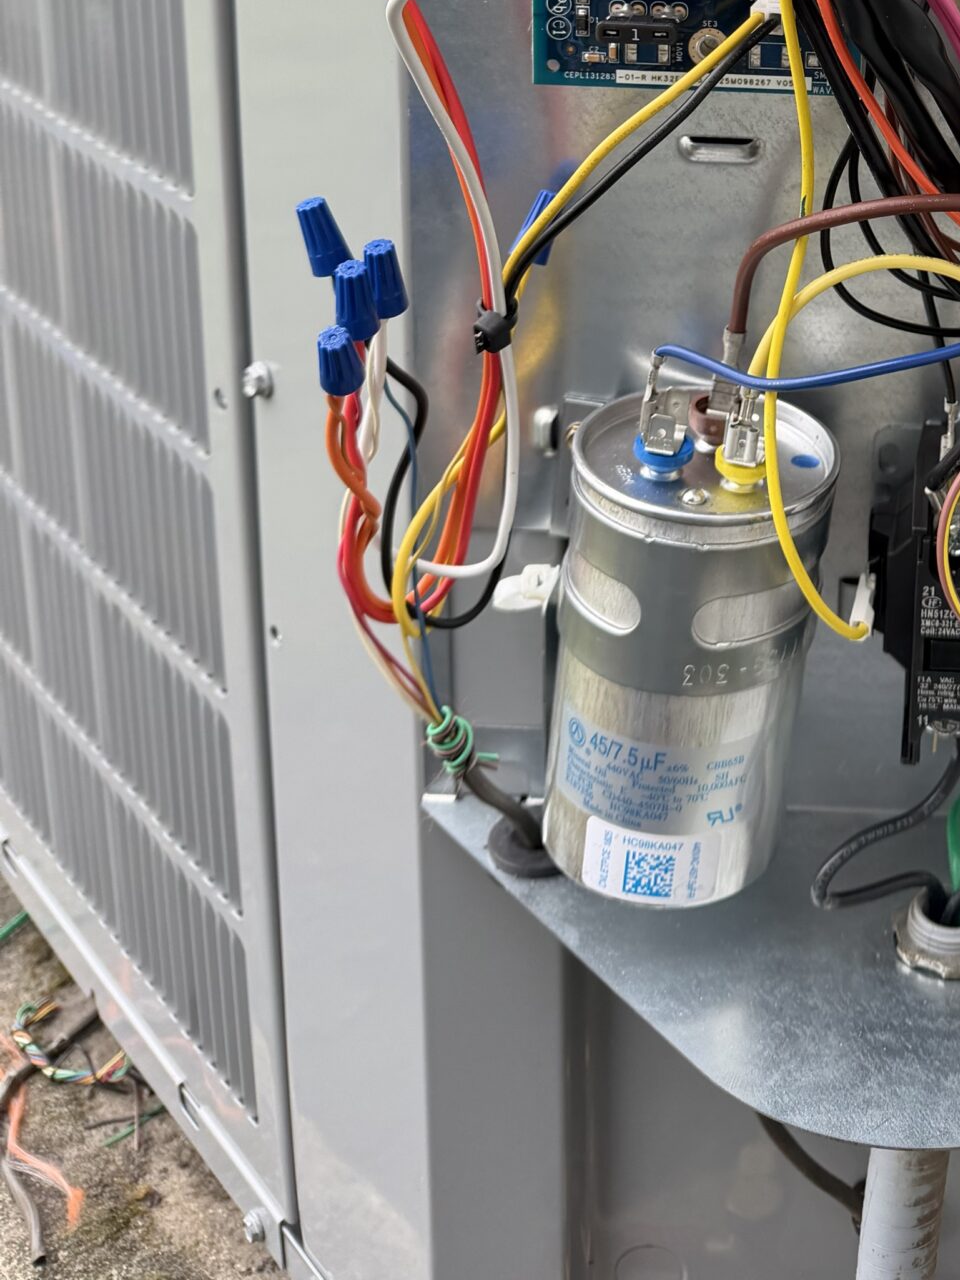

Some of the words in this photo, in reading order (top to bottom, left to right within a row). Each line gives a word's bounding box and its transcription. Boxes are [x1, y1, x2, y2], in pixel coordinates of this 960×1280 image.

[564, 70, 616, 80] CEPL131283
[922, 585, 936, 597] 21
[916, 714, 929, 726] 11
[622, 835, 684, 851] HC98KA047
